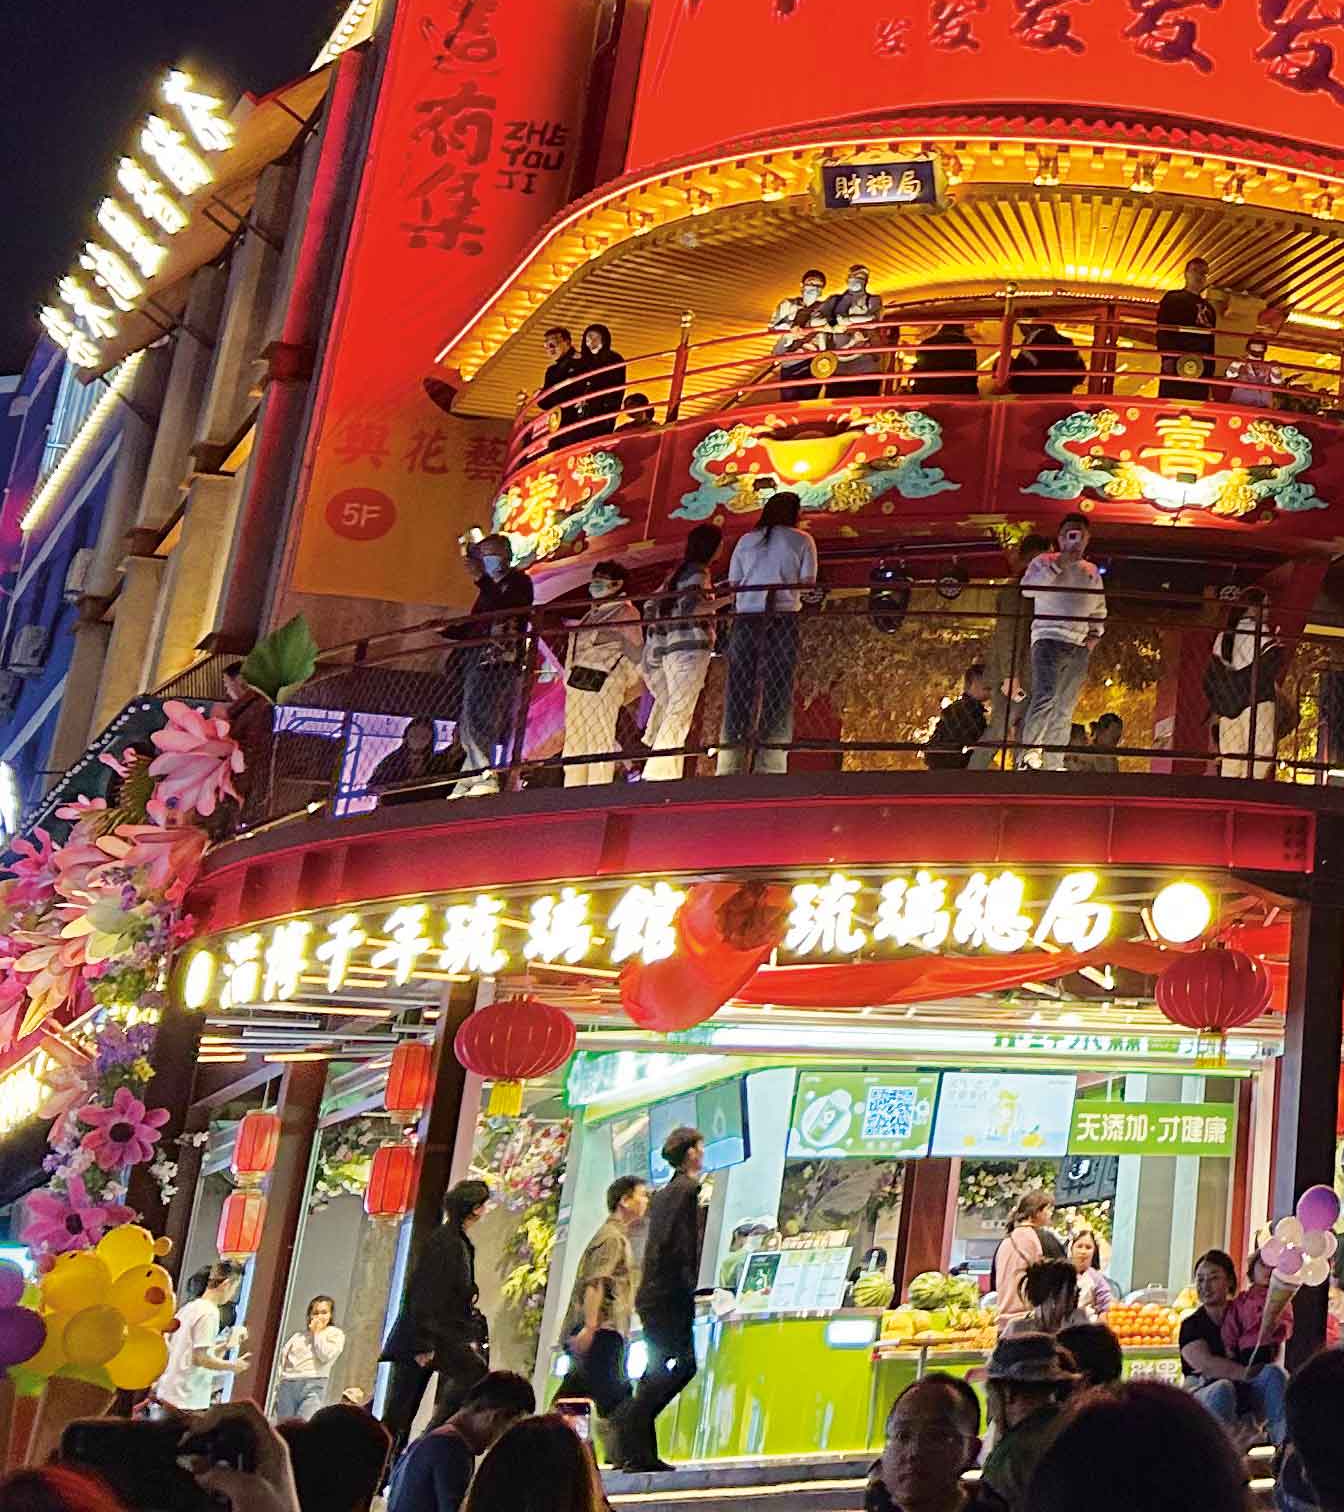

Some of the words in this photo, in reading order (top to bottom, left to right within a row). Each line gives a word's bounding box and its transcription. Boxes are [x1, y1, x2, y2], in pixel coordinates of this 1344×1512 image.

[503, 120, 569, 148] ZHE
[502, 145, 565, 172] YOU
[832, 167, 926, 204] 財神局
[1140, 414, 1224, 478] 喜
[342, 503, 383, 529] 5F
[1077, 1114, 1228, 1143] 无添加·才健康
